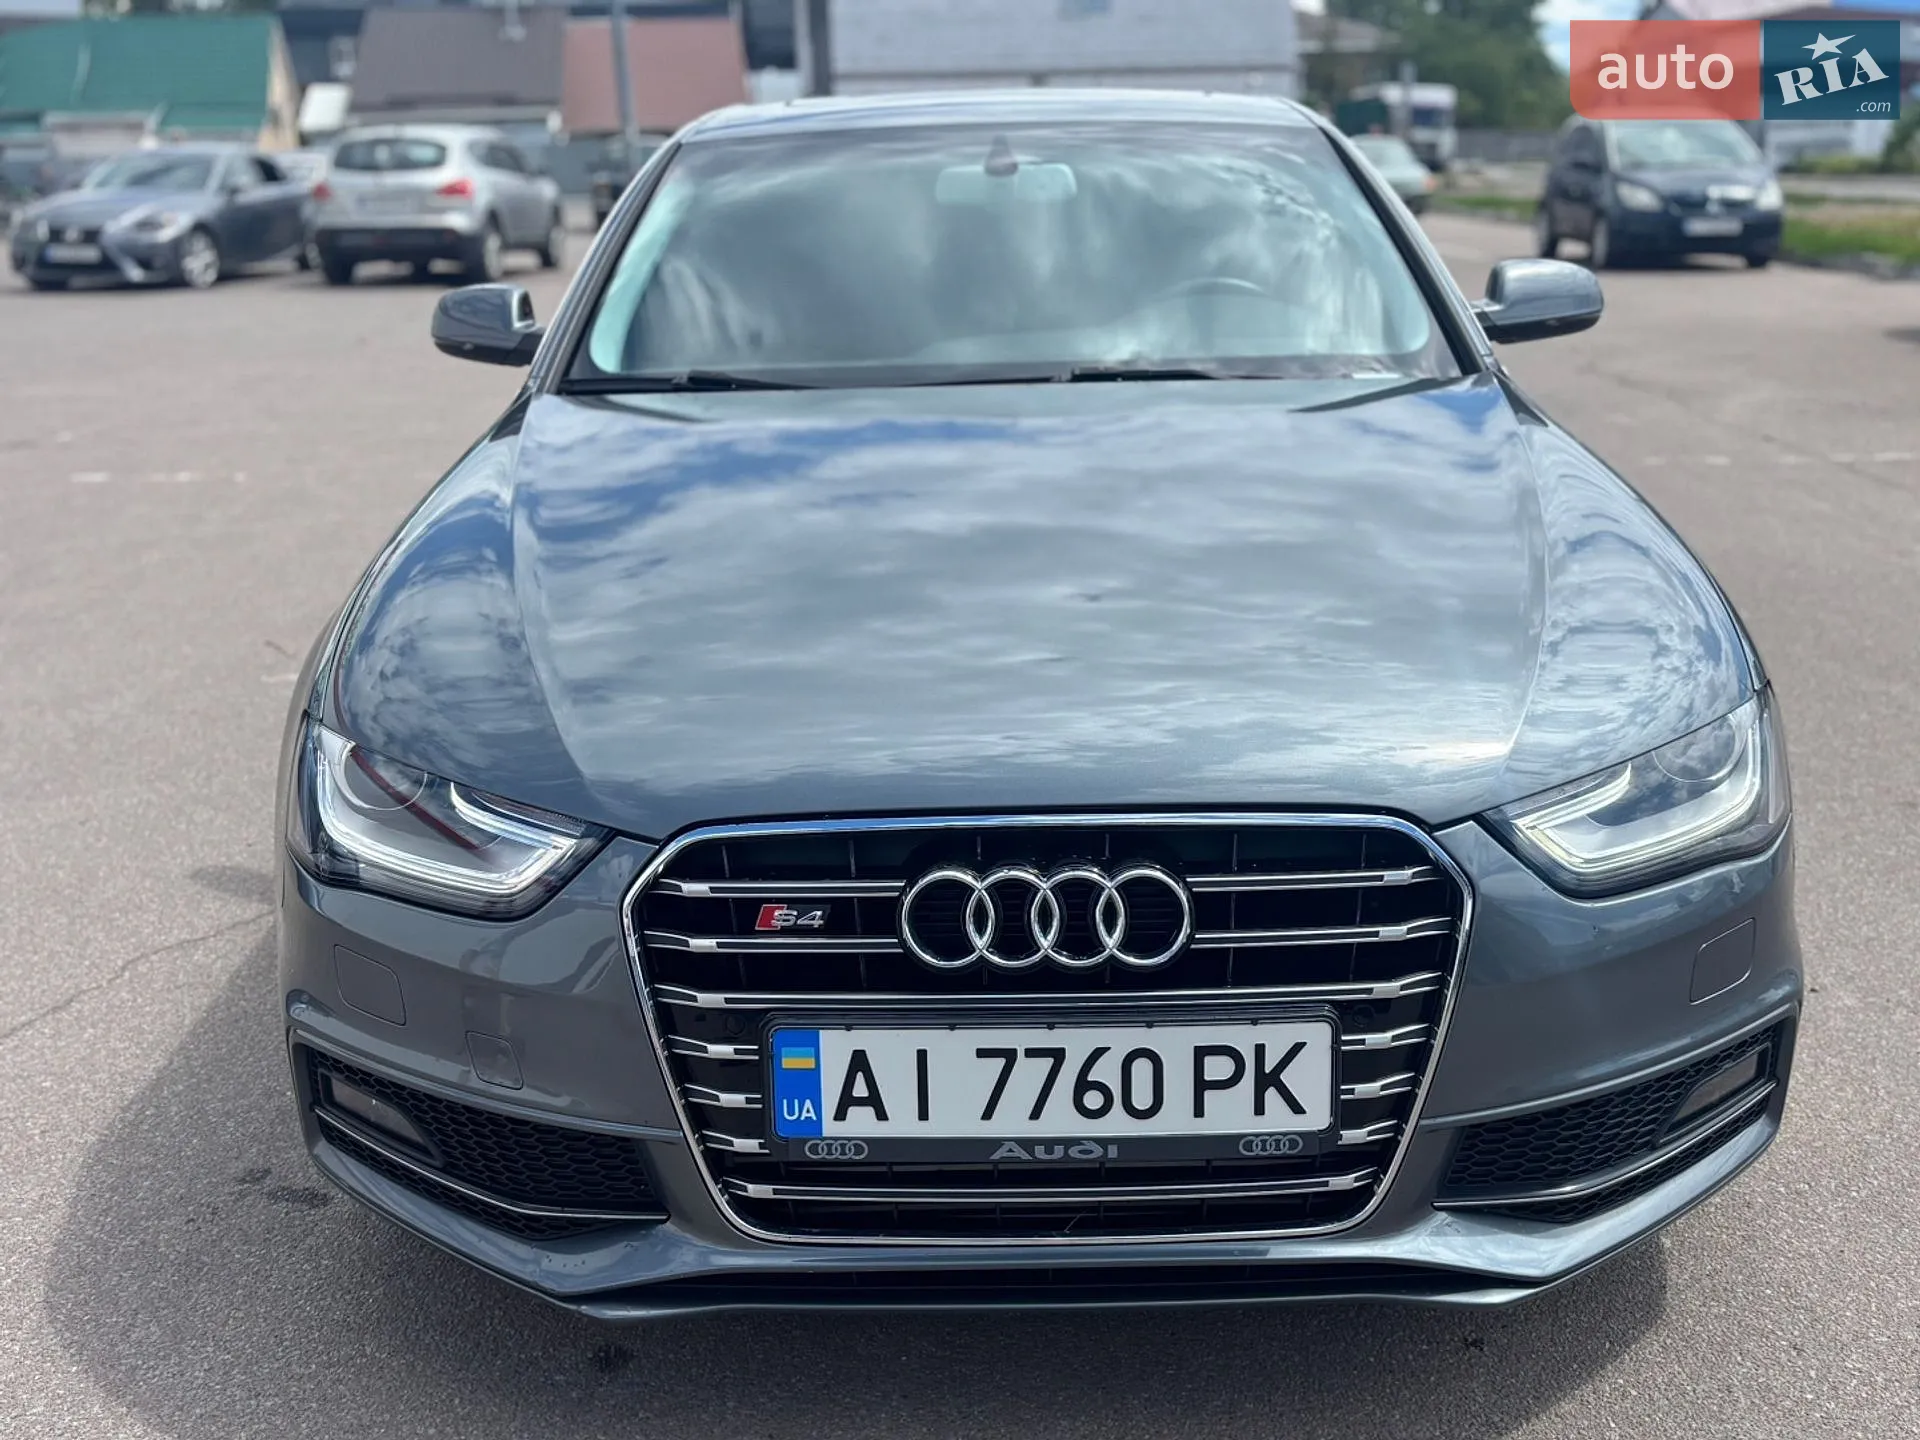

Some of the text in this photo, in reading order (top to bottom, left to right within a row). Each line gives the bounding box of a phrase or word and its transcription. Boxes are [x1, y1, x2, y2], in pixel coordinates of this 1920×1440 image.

[770, 909, 824, 928] S4
[832, 1041, 1308, 1122] AI 7760 PK
[782, 1098, 818, 1121] UA
[989, 1140, 1118, 1160] Audi
